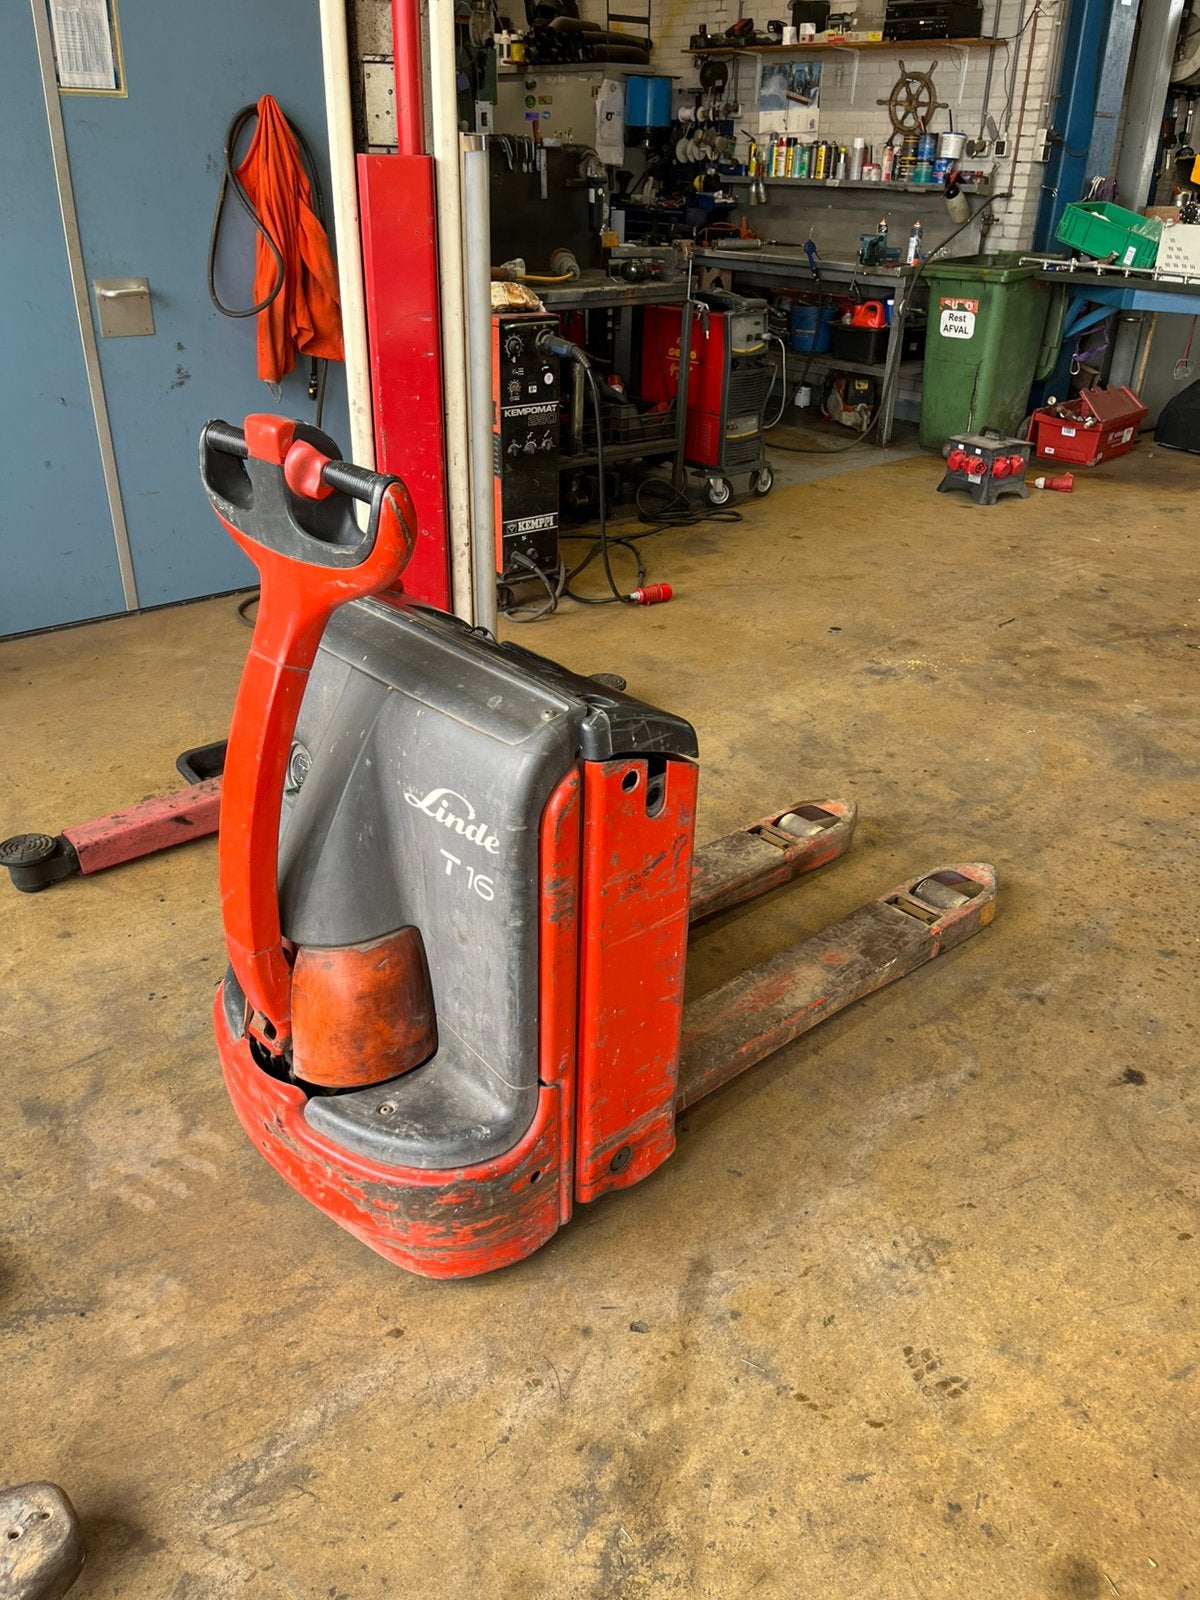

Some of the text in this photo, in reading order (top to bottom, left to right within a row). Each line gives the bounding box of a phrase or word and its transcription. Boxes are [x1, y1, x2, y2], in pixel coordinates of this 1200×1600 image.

[944, 300, 973, 310] SUO
[948, 313, 966, 322] Rest
[943, 324, 969, 334] AFVAL
[504, 404, 557, 417] KEMPOMAT
[518, 516, 553, 531] KEMPPI
[404, 788, 499, 854] Linde
[440, 848, 494, 901] T 16
